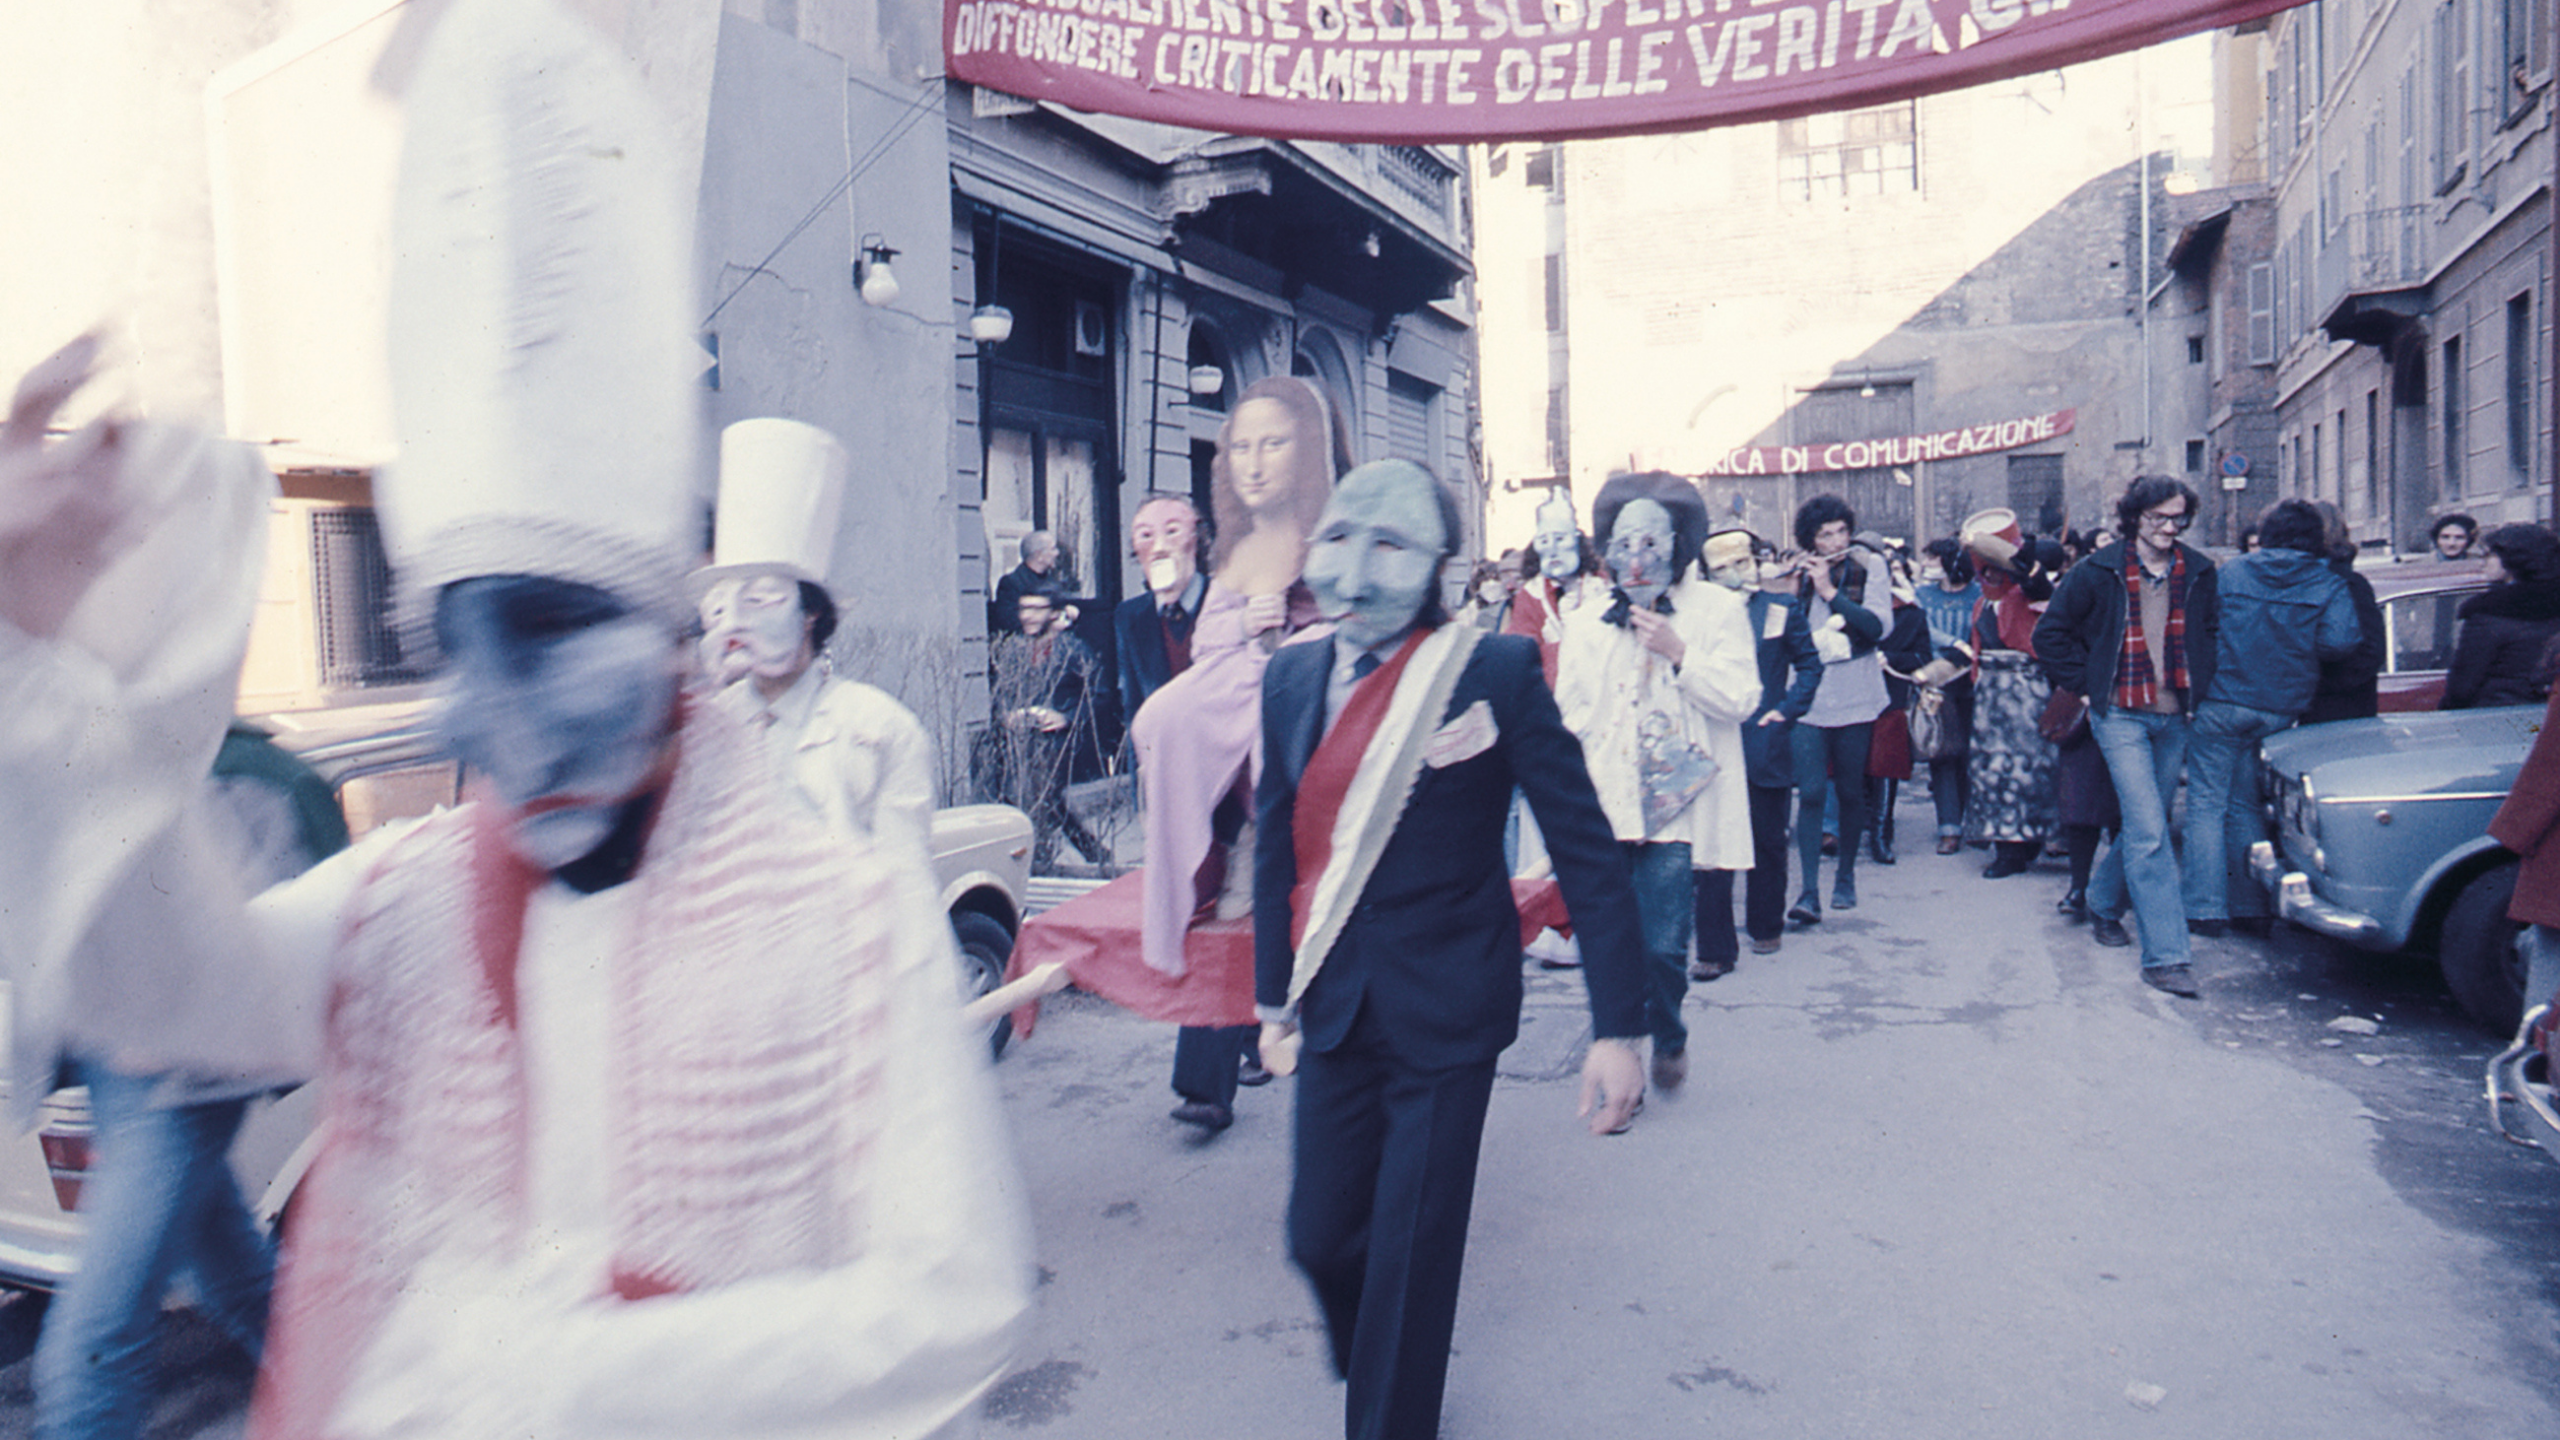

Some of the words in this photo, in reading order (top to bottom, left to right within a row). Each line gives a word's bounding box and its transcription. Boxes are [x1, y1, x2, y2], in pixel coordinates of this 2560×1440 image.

[1308, 0, 1468, 41] DELLE
[954, 2, 1144, 78] DIFFONDERE
[1155, 33, 1482, 103] CRITICAMENTE
[1496, 31, 1674, 103] DELLE
[1781, 446, 1808, 473] DI
[1823, 413, 2057, 470] COMUNICAZIONE
